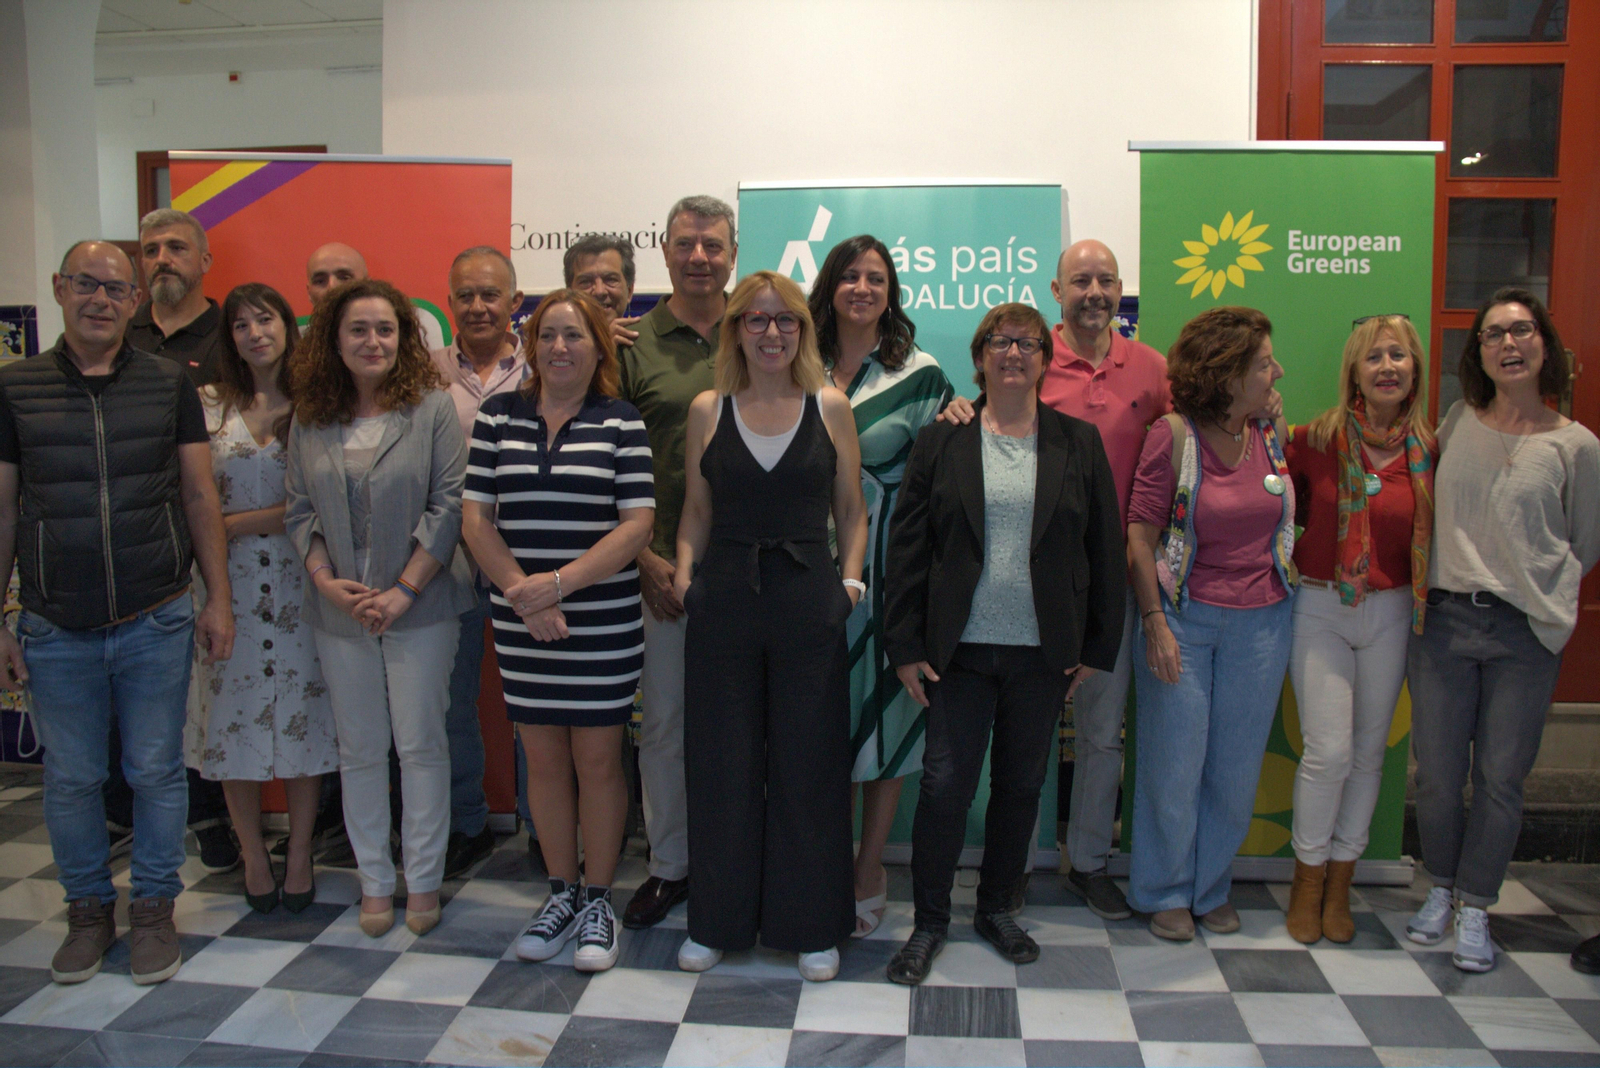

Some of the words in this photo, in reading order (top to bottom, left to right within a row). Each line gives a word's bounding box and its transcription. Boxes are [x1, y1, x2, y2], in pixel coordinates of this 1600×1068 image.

[1288, 229, 1402, 257] European
[887, 236, 937, 273] ás
[951, 236, 1038, 282] país
[1287, 252, 1371, 274] Greens
[899, 277, 1039, 310] DALUCÍA
